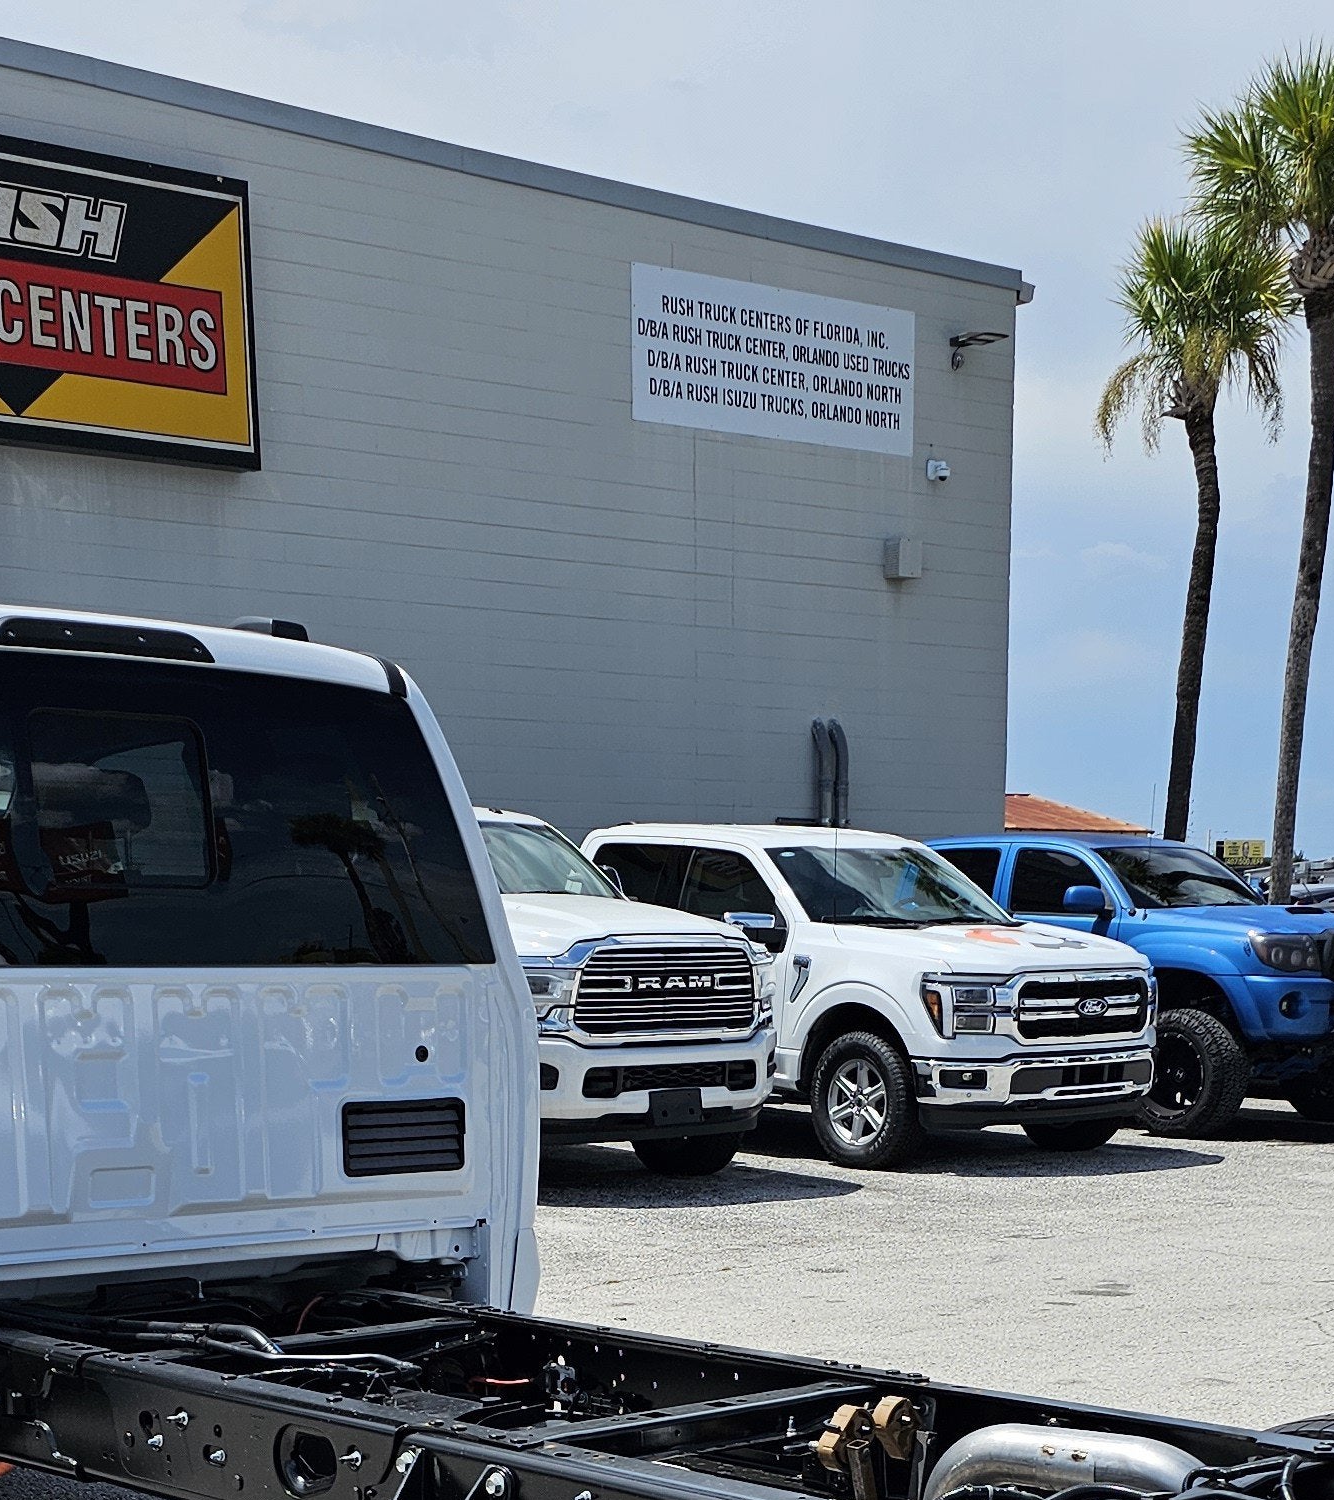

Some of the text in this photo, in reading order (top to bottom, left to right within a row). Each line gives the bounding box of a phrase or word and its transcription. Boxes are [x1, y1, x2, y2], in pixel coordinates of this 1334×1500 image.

[637, 318, 910, 380] D/B/A RUSH TRUCK CENTER, ORLANDO USED TRUCKS
[661, 294, 889, 350] RUSH TRUCK CENTERS OF FLORIDA, INC.
[647, 349, 902, 404] D/B/A RUSH TRUCK CENTER, ORLANDO NORTH
[649, 377, 900, 431] D/B/A RUSH ISUZU TRUCKS, ORLANDO NORTH
[637, 975, 712, 989] RAM
